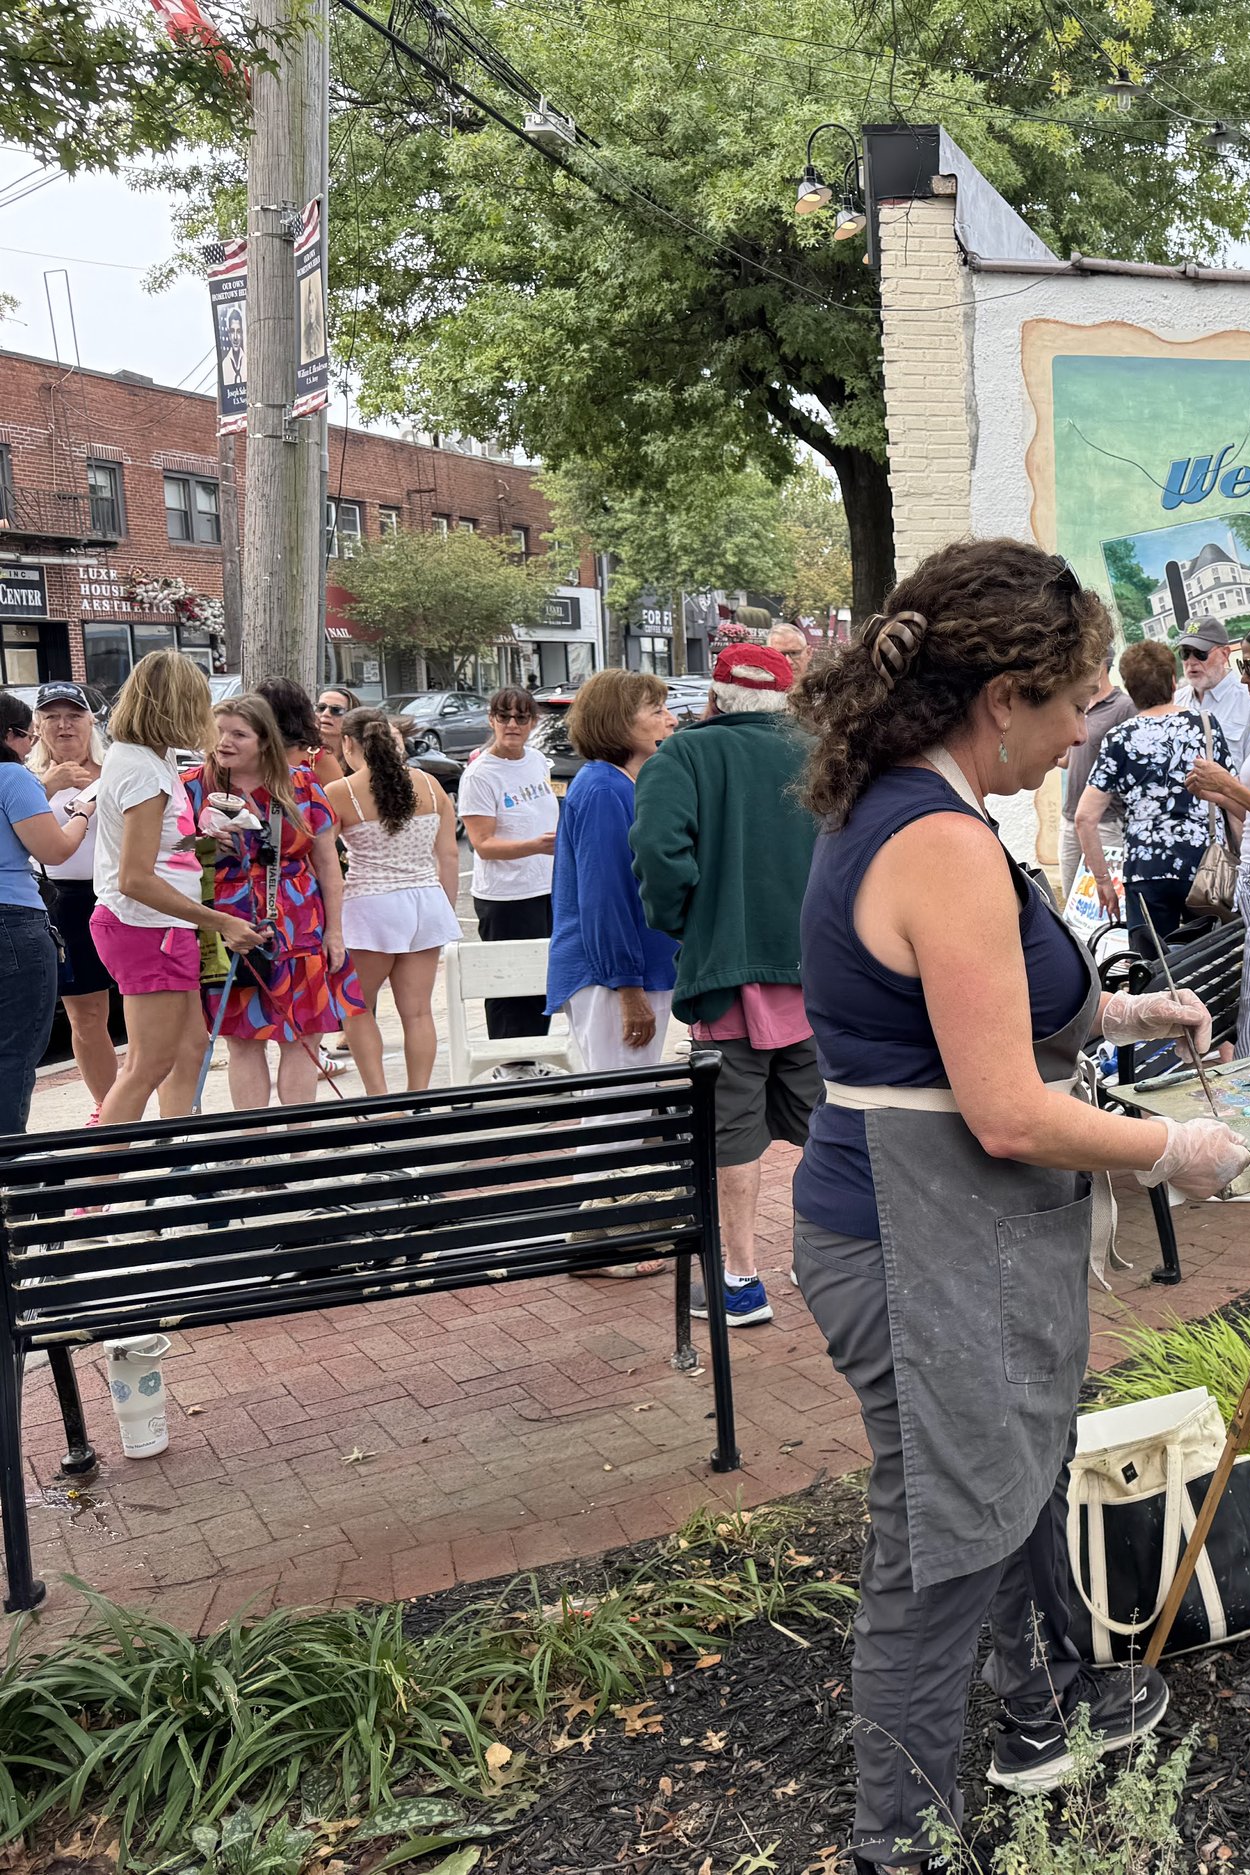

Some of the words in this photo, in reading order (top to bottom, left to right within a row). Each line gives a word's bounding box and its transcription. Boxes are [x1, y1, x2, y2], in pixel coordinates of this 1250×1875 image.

[79, 567, 118, 580] LUXE
[0, 583, 42, 607] CENTER
[663, 611, 672, 625] FI
